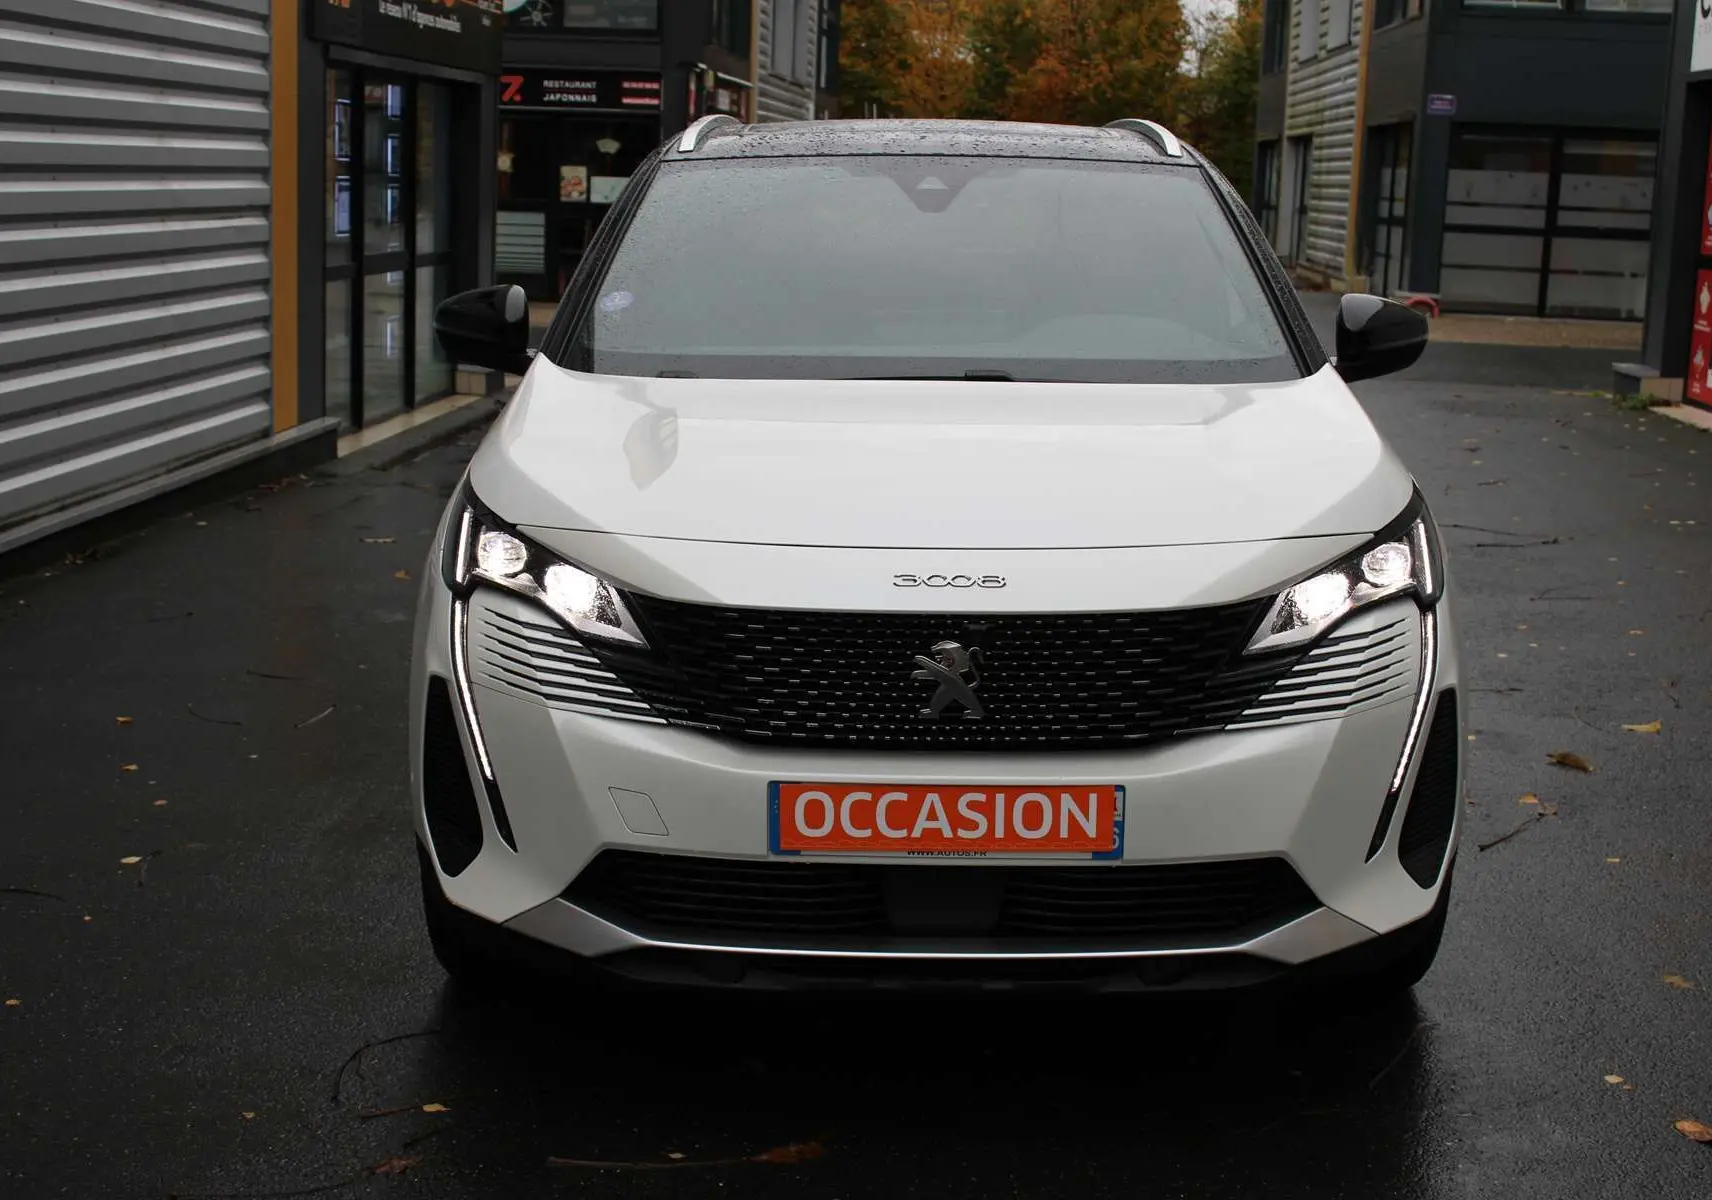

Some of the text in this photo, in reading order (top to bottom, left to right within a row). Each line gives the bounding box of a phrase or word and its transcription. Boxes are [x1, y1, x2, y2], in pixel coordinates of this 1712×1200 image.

[543, 80, 597, 89] RESTAURANT
[543, 93, 597, 103] JAPONNAIS
[893, 574, 1007, 588] 3008
[794, 791, 1098, 839] OCCASION
